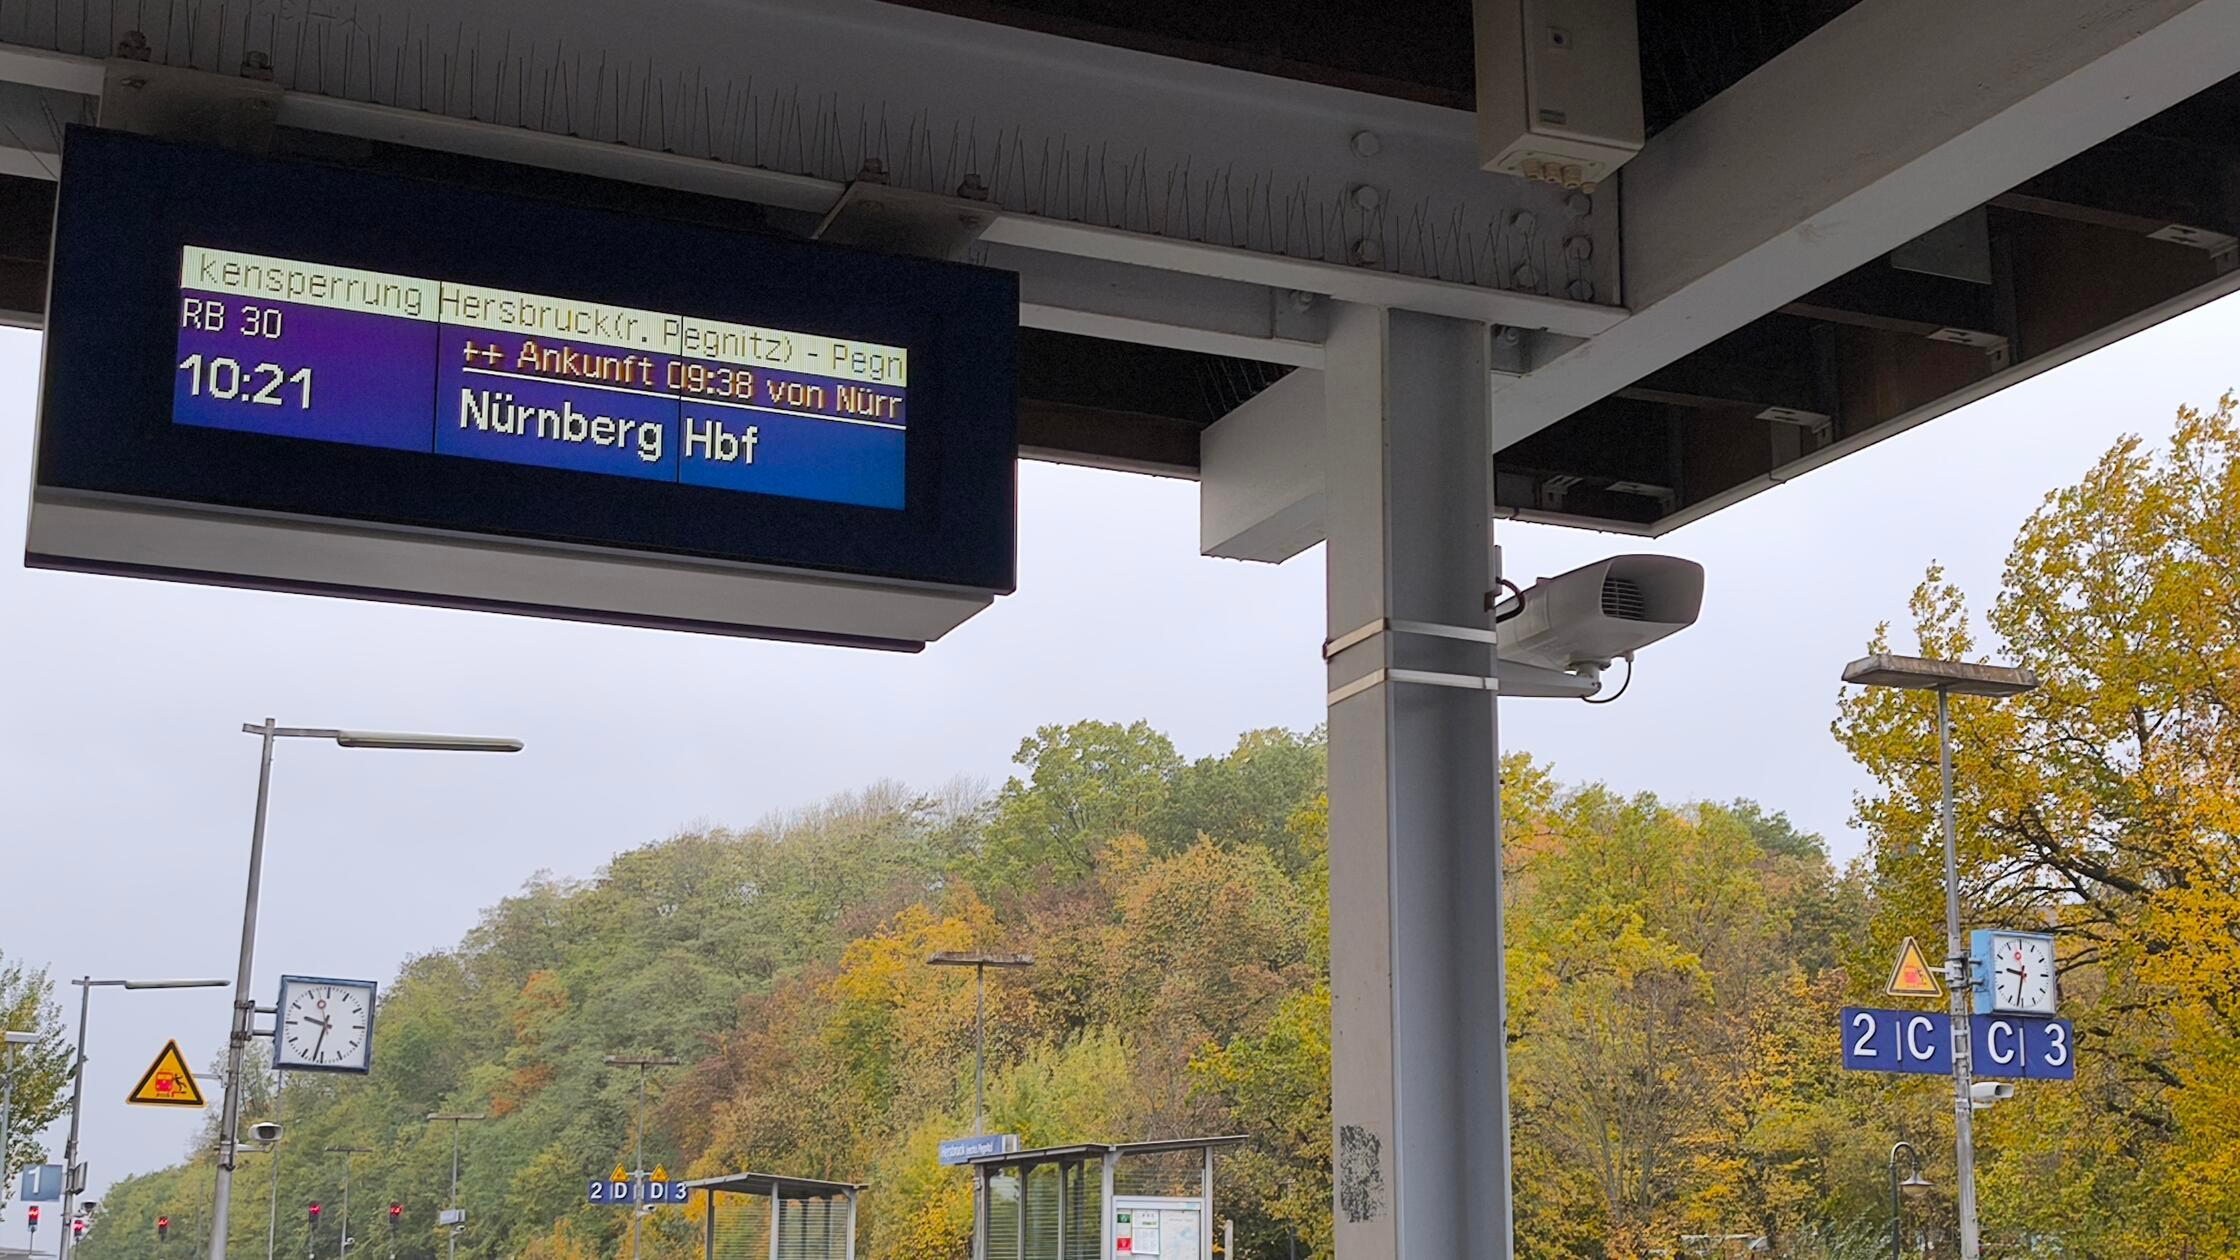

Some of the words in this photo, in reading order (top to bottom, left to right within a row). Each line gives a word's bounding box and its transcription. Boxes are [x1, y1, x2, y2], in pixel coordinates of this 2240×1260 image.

[182, 297, 225, 332] RB
[240, 305, 283, 339] 30
[200, 252, 422, 317] kensperrung
[663, 318, 793, 364] Pegnitz)
[832, 343, 903, 381] Pegn
[179, 353, 312, 410] 10:21
[517, 340, 655, 386] Ankunft
[667, 360, 755, 400] 09:38
[766, 379, 825, 411] von
[459, 387, 664, 462] Nürnberg
[684, 417, 759, 465] Hbf
[1852, 1012, 1878, 1057] 2
[1907, 1016, 1936, 1060] C
[1987, 1021, 2015, 1064] C
[2043, 1023, 2068, 1067] 3
[27, 1166, 41, 1193] 1
[590, 1182, 603, 1199] 2
[614, 1182, 628, 1200] D
[651, 1182, 664, 1199] D
[675, 1183, 688, 1200] 3
